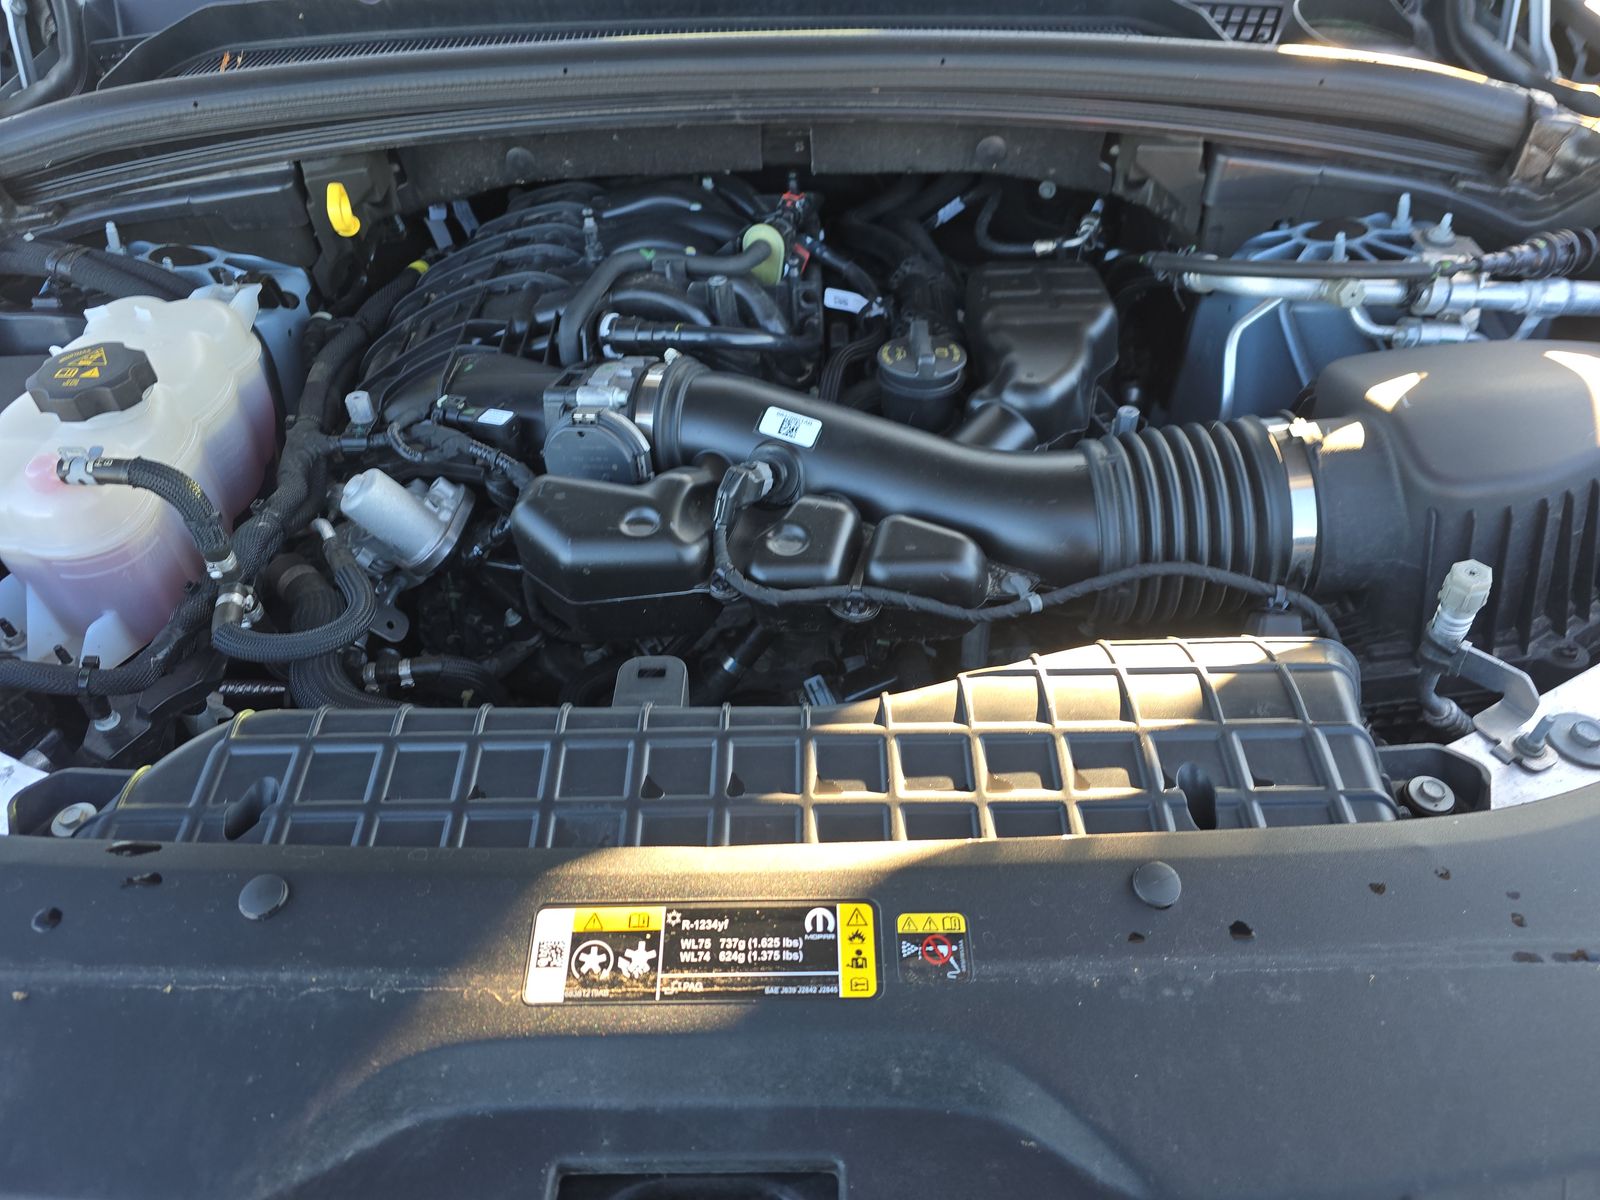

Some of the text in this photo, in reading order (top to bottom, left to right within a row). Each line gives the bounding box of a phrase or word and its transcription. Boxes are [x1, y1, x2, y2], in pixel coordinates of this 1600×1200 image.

[681, 918, 730, 932] R-1234yf
[680, 937, 804, 951] WL75 737g (1.625 lbs)
[804, 933, 836, 941] MOPAR
[679, 950, 804, 964] WL74 624g (1.375 lbs)
[682, 981, 704, 993] PAG
